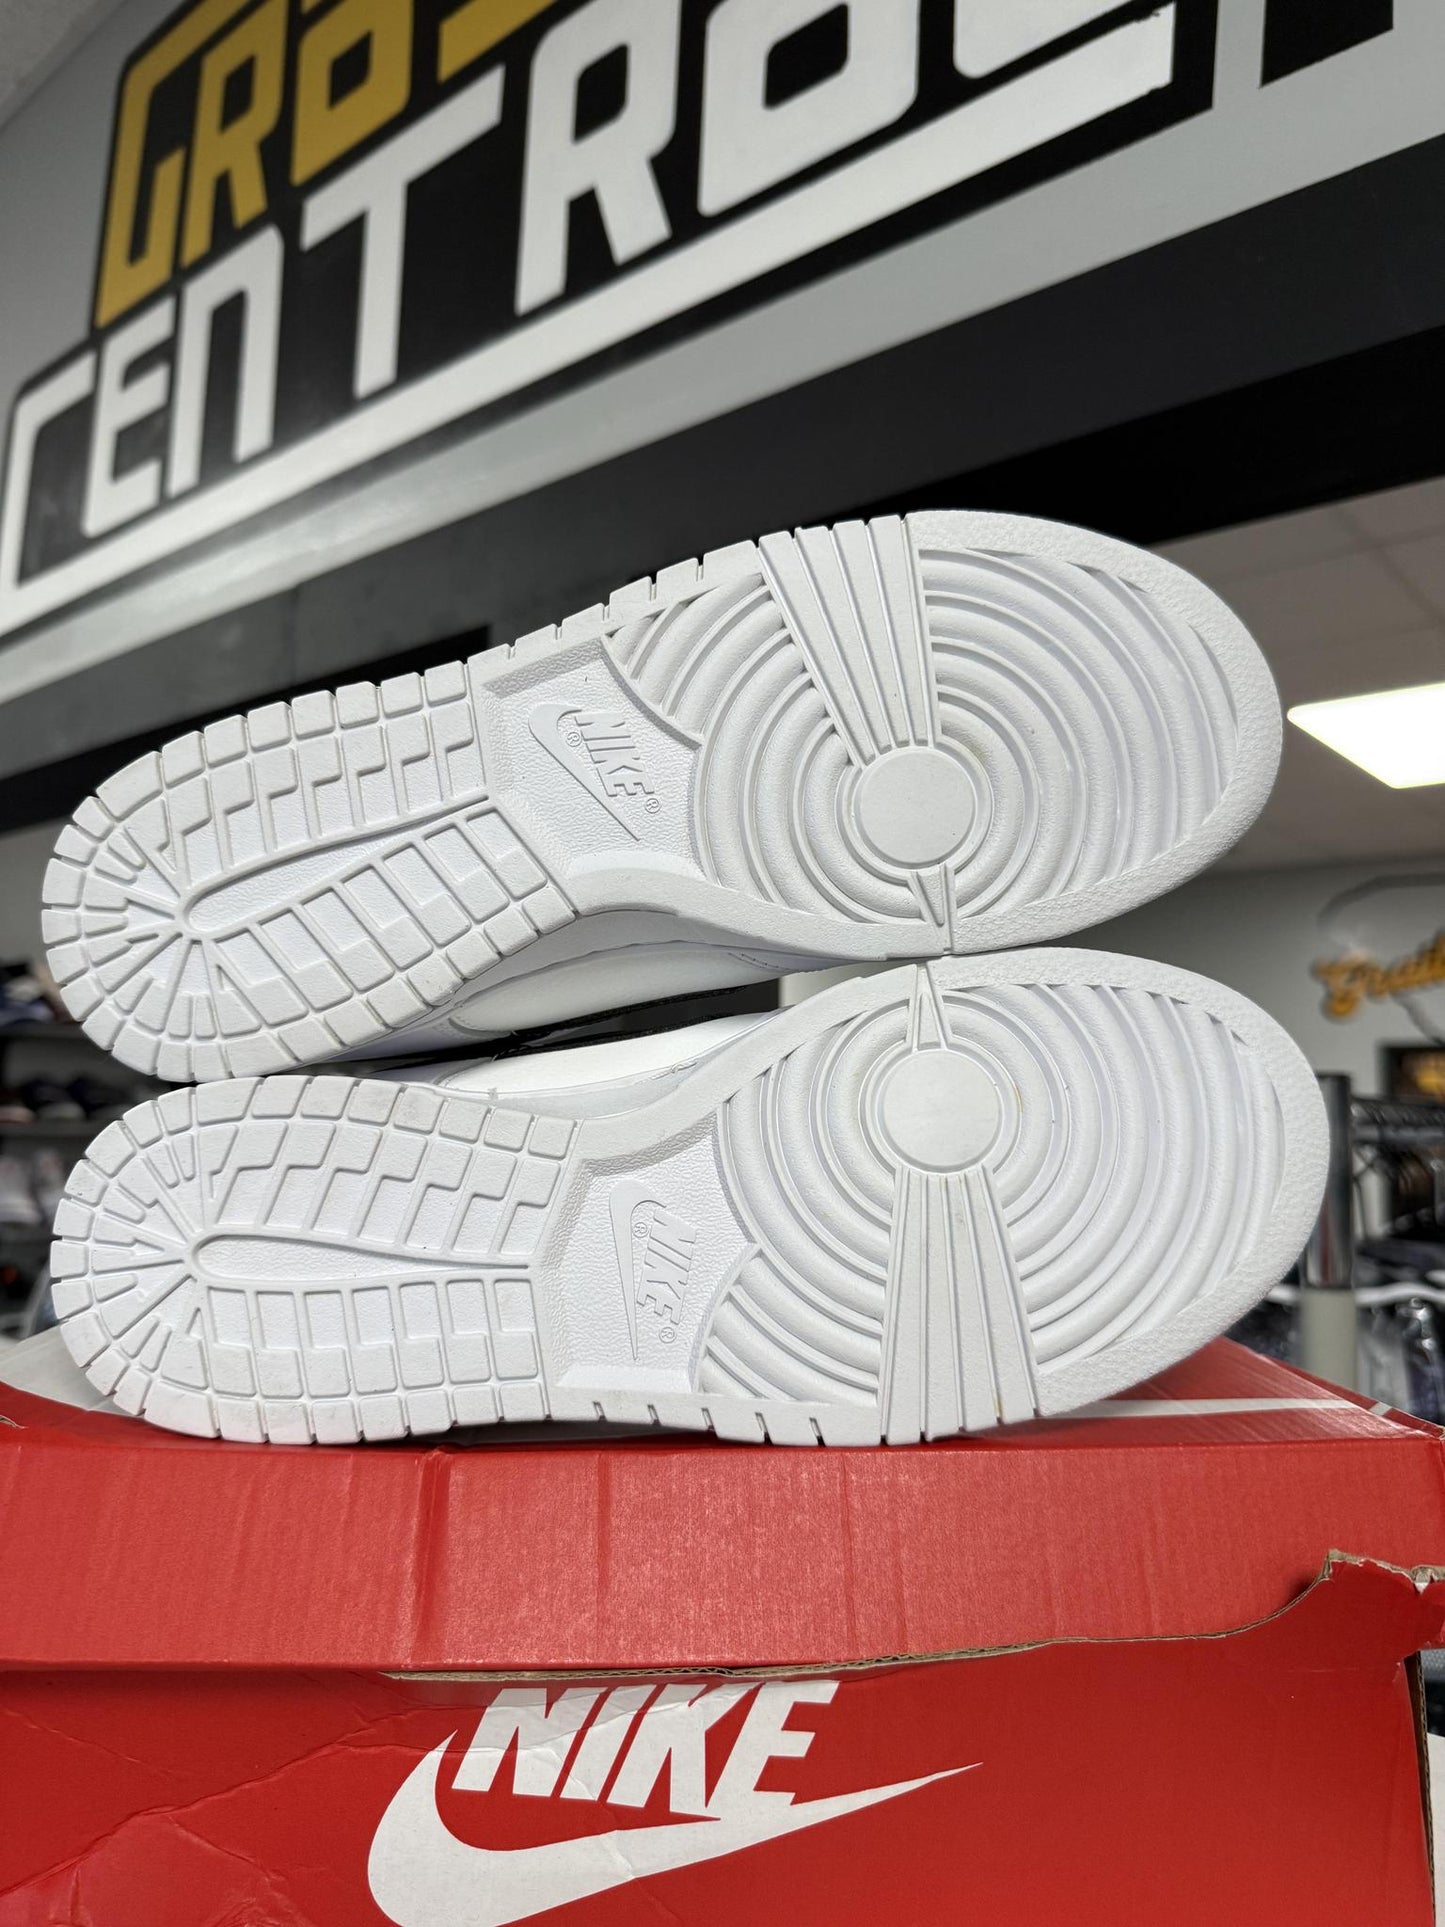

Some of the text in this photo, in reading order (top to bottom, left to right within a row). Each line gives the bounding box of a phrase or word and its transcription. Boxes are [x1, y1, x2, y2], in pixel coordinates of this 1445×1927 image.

[574, 711, 655, 797] NIKE
[637, 1209, 697, 1326] NIKE
[451, 1681, 840, 1820] NIKE
